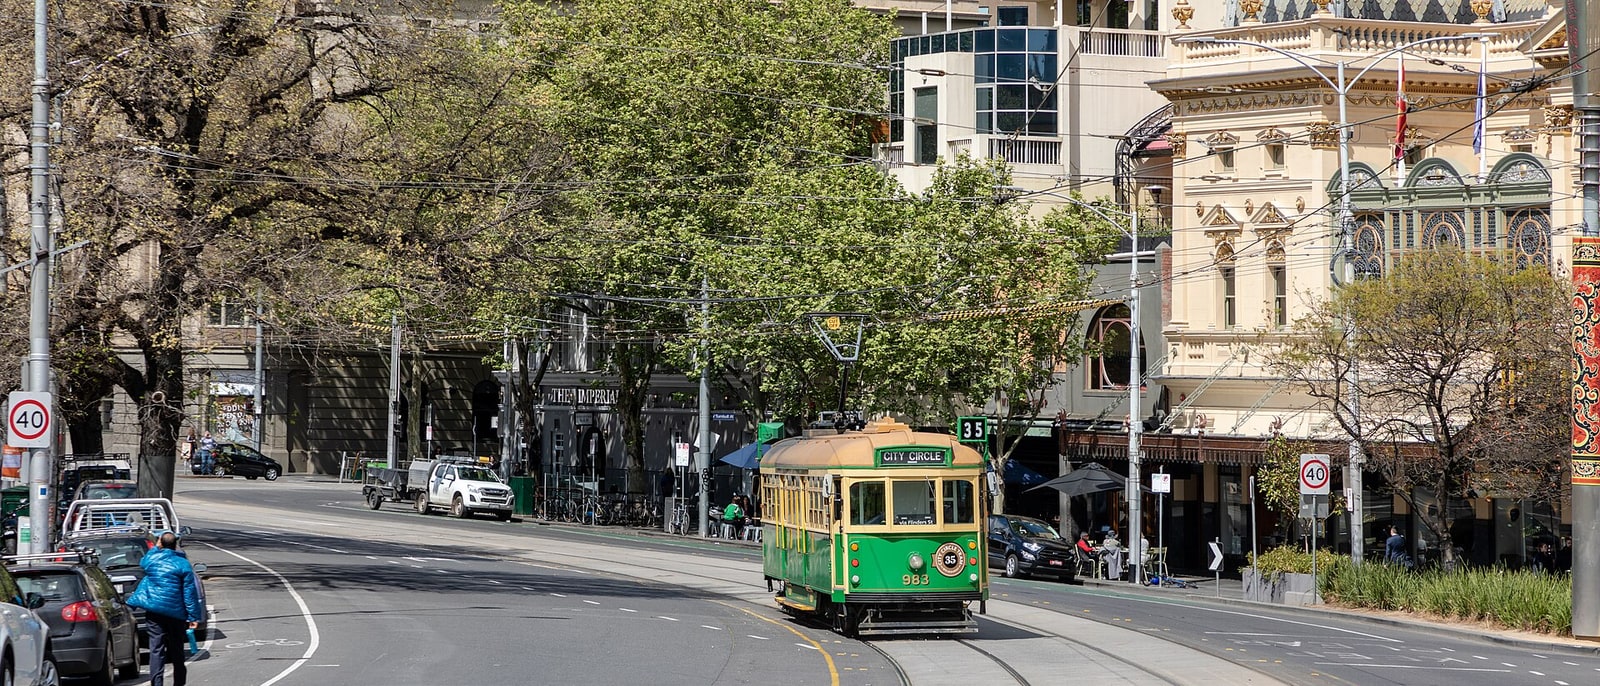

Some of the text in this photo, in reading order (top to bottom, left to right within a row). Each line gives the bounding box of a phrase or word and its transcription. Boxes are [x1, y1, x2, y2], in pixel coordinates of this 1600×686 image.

[552, 388, 571, 403] THE
[16, 410, 43, 428] 40
[963, 421, 983, 438] 35
[883, 452, 941, 461] CITY CIRCLE
[1306, 468, 1324, 481] 40
[940, 545, 957, 554] CIRCLE
[944, 555, 957, 565] 35
[902, 574, 930, 585] 983
